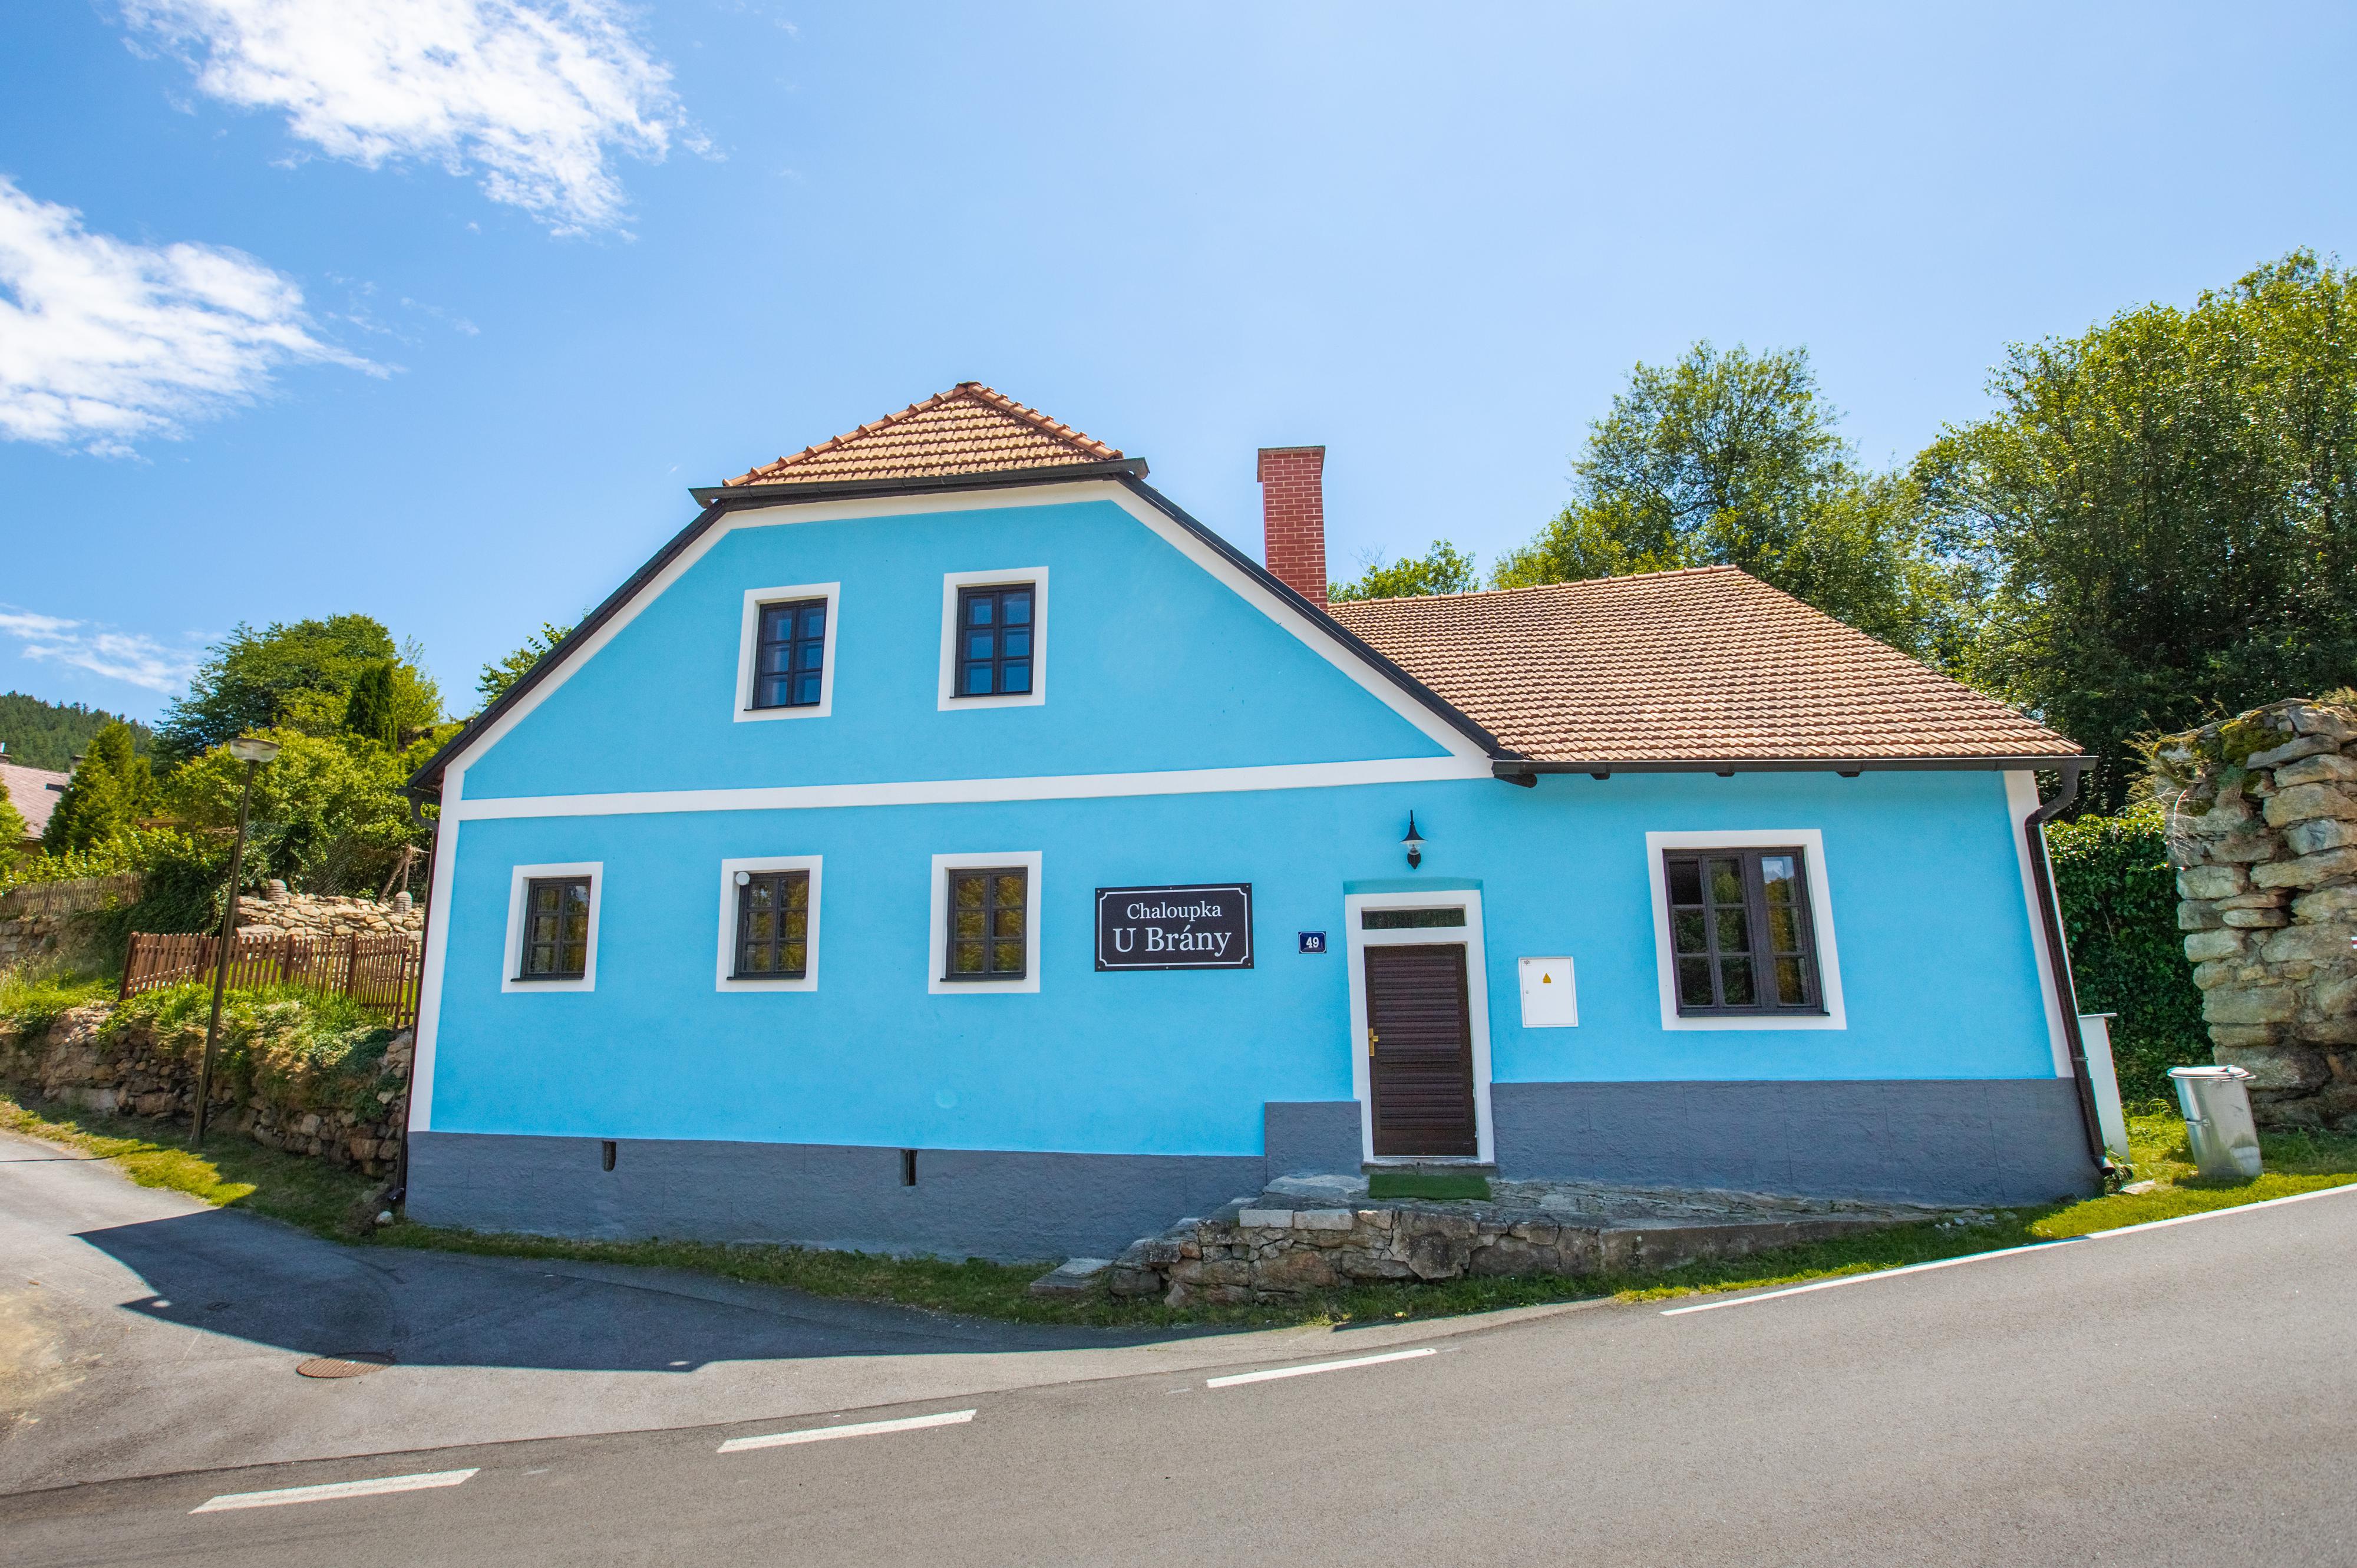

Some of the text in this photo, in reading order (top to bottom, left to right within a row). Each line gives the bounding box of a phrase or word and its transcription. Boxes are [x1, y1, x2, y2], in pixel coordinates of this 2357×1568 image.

[1127, 900, 1222, 922] Chaloupka
[1113, 924, 1232, 957] U Brány
[1306, 936, 1320, 949] 49
